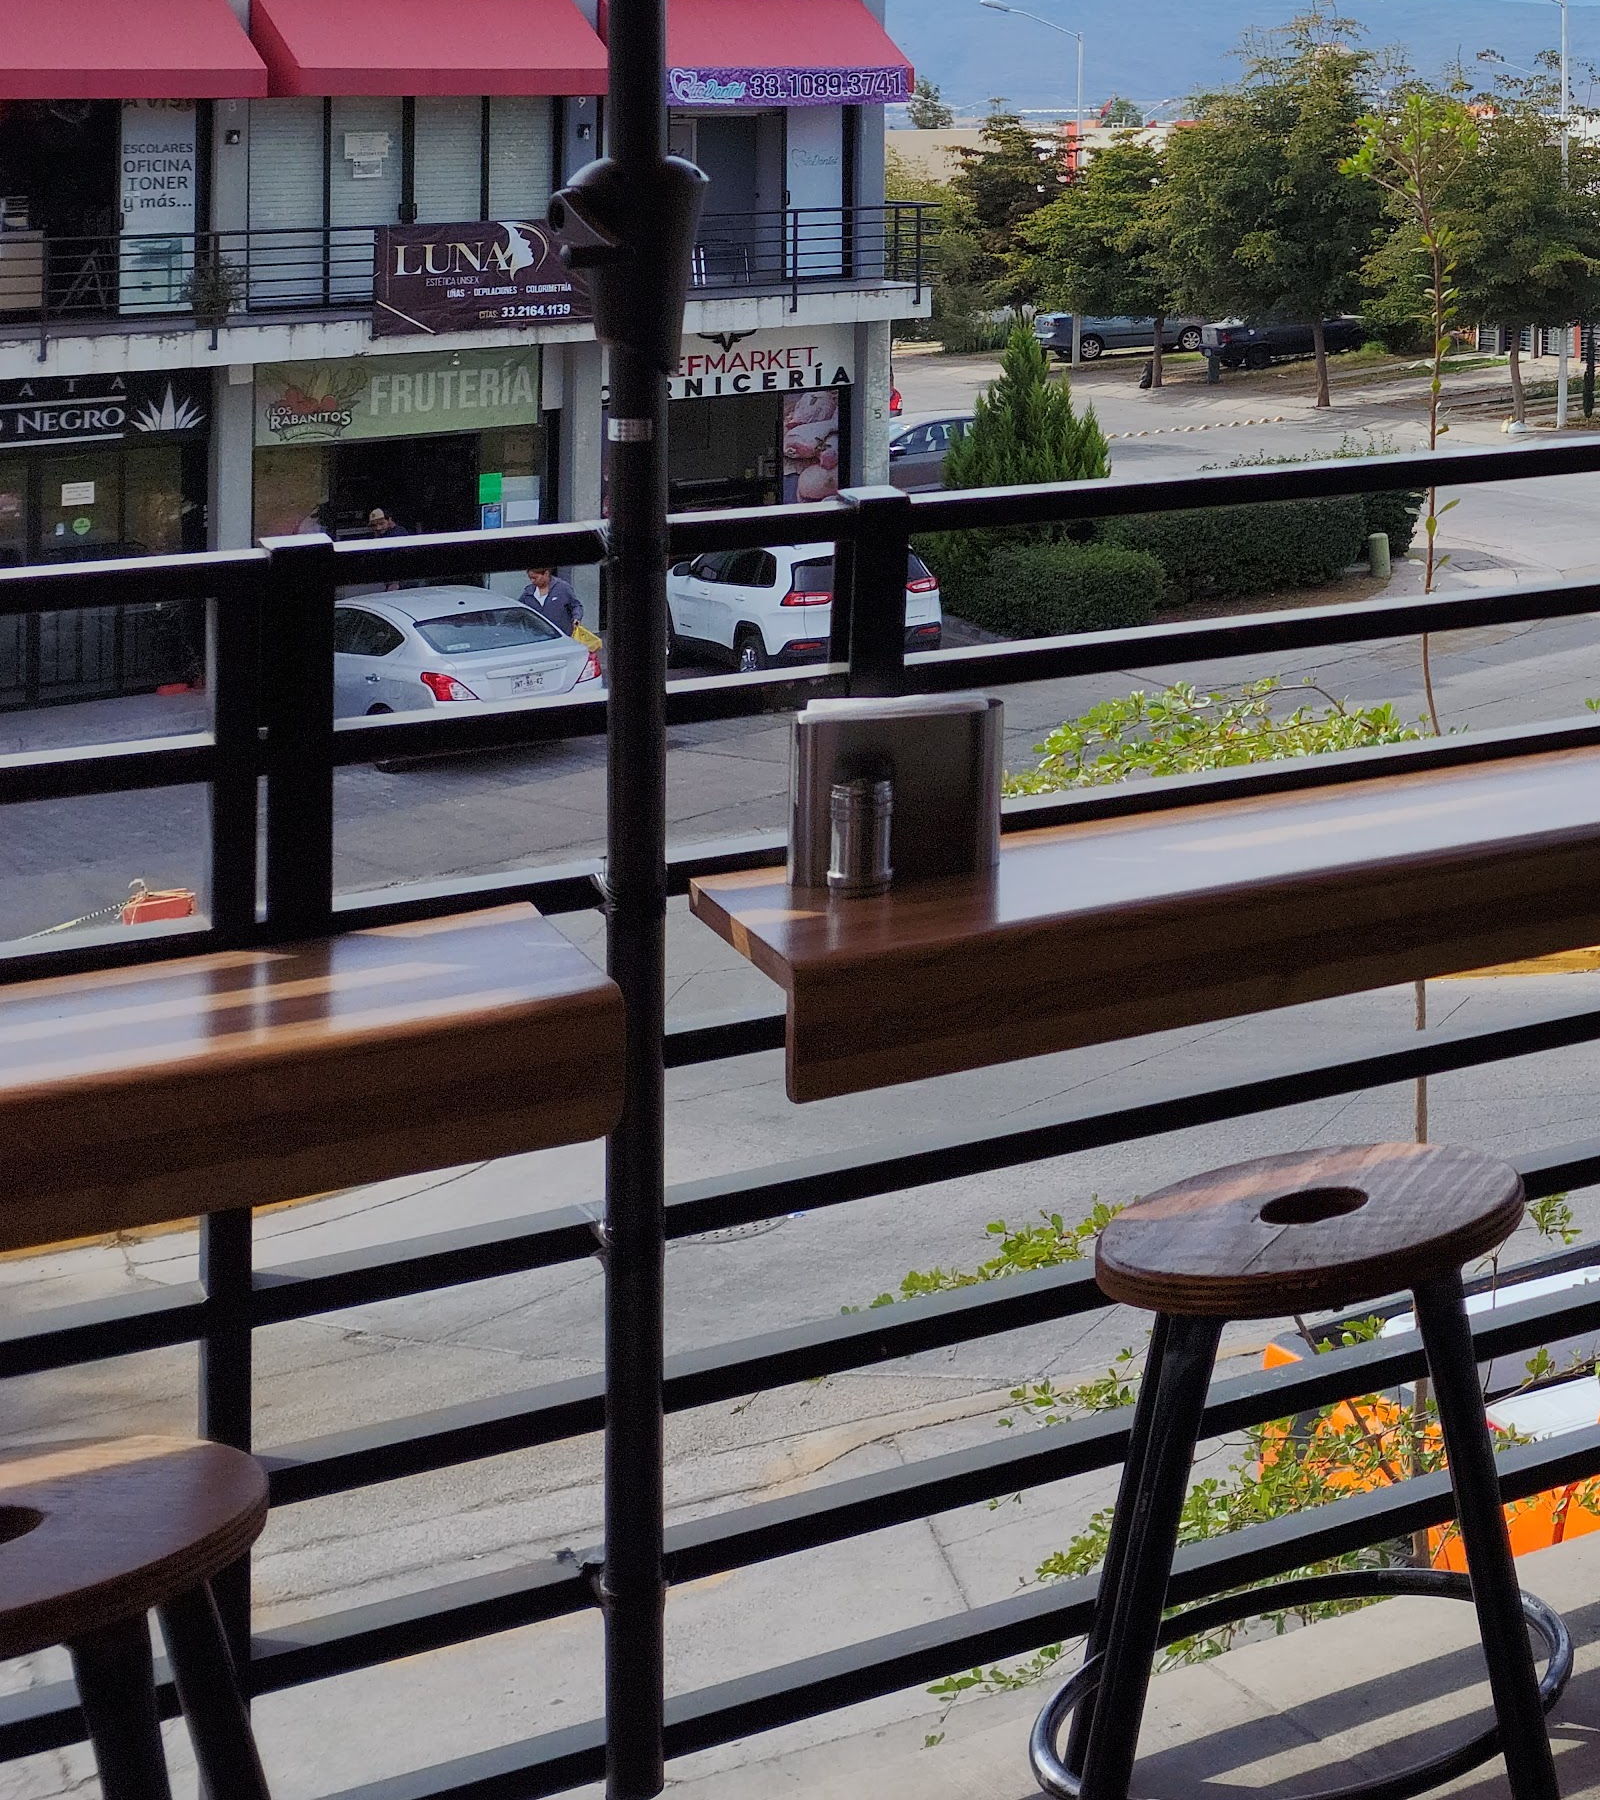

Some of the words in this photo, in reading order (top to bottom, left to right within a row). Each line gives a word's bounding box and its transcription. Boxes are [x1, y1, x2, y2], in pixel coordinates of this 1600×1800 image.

[751, 72, 901, 98] 33.1089.3741
[578, 96, 587, 109] 9
[123, 143, 193, 154] ESCOLARES
[123, 159, 193, 173] OFICINA
[127, 176, 188, 191] TONER
[123, 196, 134, 212] y
[394, 241, 513, 276] LUNA
[457, 275, 480, 286] UNISEX
[501, 304, 571, 318] 33.2164.1139
[369, 358, 534, 416] FRUTERÍA
[272, 406, 292, 415] LOS
[874, 408, 882, 420] 5
[270, 411, 351, 430] RABANITOS
